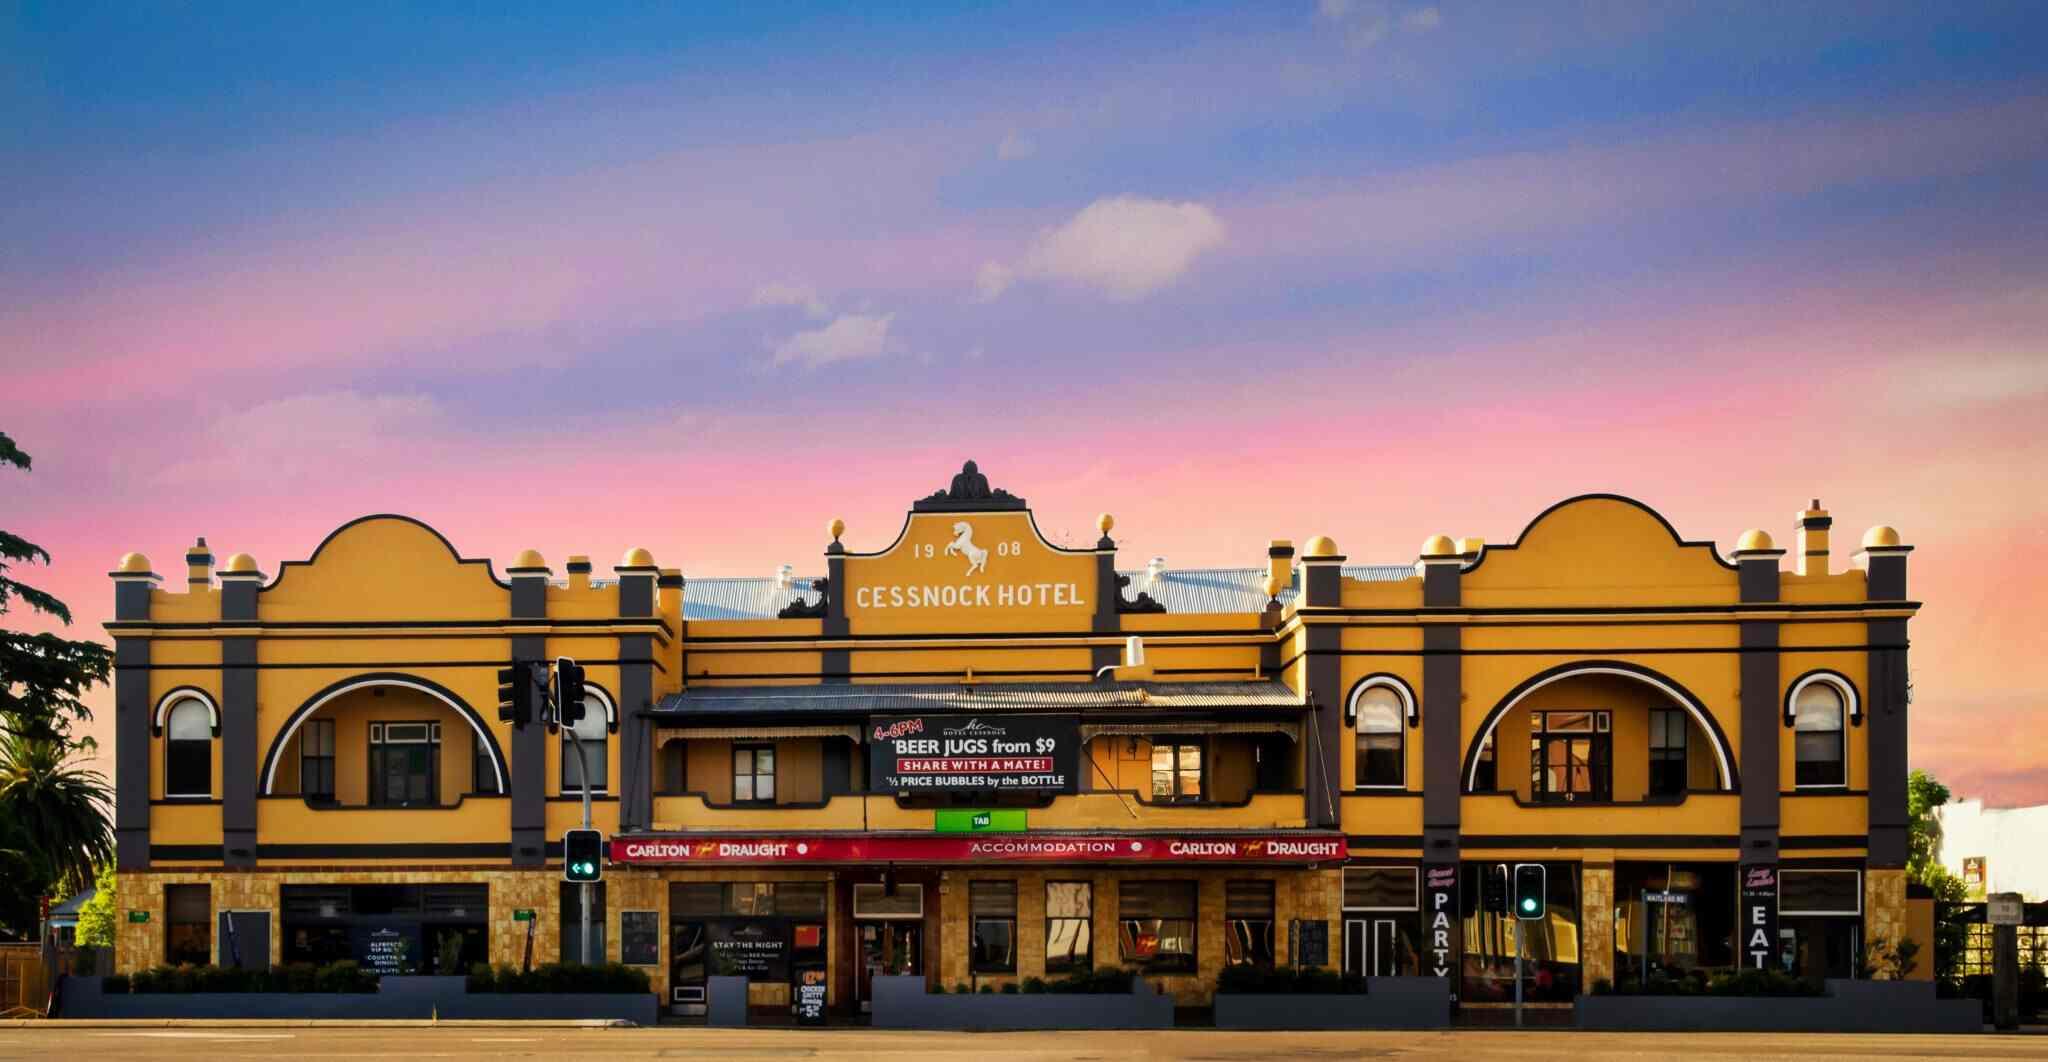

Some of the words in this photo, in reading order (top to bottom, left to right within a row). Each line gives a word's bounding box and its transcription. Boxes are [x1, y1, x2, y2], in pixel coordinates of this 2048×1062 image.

[856, 585, 991, 608] CESSNOCK
[997, 583, 1085, 606] HOTEL
[873, 718, 925, 740] 4-6PM
[944, 738, 988, 757] JUGS
[992, 738, 1031, 754] from
[1035, 737, 1056, 753] $9
[903, 760, 948, 771] SHARE
[952, 760, 988, 770] WITH
[990, 760, 1001, 770] A
[1004, 759, 1046, 770] MATE!
[901, 776, 933, 786] PRICE
[934, 776, 985, 786] BUBBLES
[987, 776, 1000, 789] by
[1002, 776, 1019, 786] the
[1021, 775, 1065, 786] BOTTLE
[973, 816, 990, 826] TAB
[626, 843, 691, 857] CARLTON
[719, 843, 789, 858] DRAUGHT
[970, 841, 1116, 854] ACCOMMODATION
[1169, 842, 1236, 857] CARLTON
[1266, 842, 1339, 857] DRAUGHT
[1432, 892, 1450, 977] PARTY
[1749, 905, 1769, 969] EAT
[713, 941, 735, 949] STAY
[736, 941, 753, 949] THE
[755, 941, 783, 949] NIGHT
